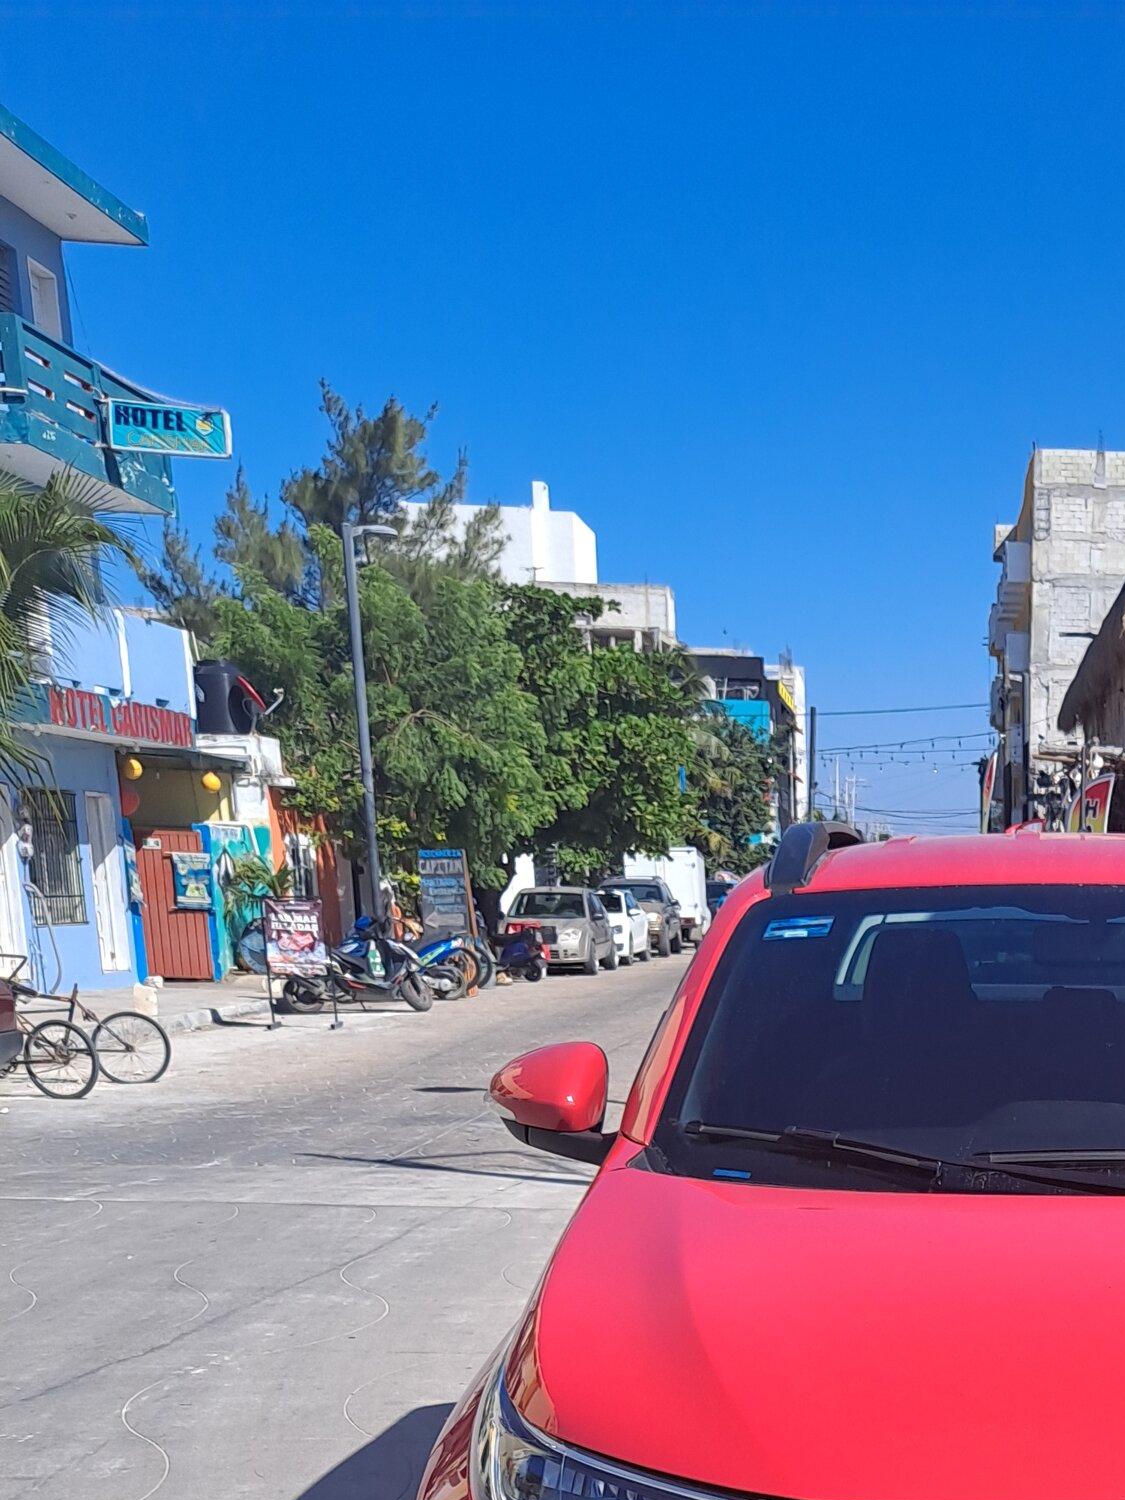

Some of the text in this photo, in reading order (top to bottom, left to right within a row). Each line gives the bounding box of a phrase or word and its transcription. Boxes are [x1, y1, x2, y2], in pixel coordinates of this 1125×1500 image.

[114, 404, 186, 432] HOTEL
[50, 686, 191, 747] HOTEL CARISMAR
